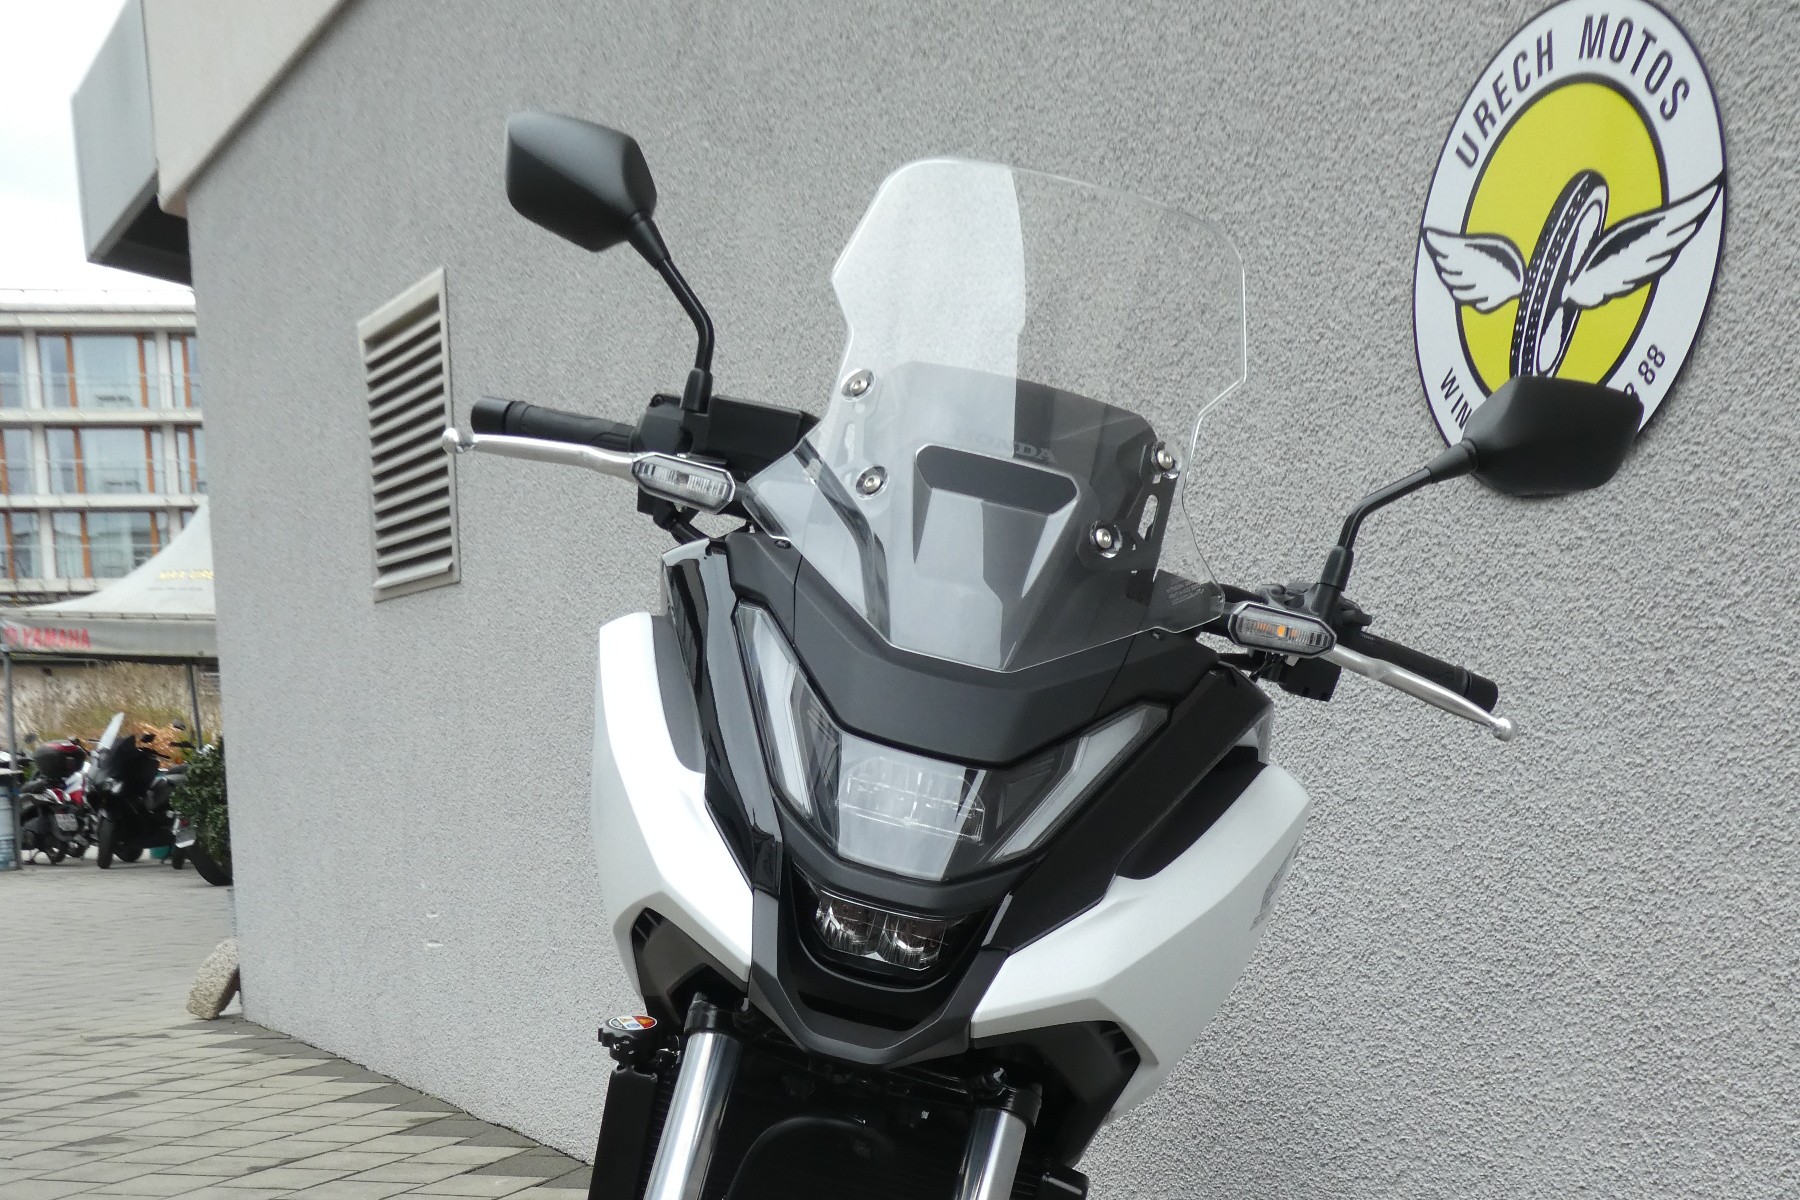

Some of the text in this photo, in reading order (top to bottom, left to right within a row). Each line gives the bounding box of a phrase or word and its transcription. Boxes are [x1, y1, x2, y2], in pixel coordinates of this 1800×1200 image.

[1455, 14, 1691, 170] URECH MOTOS
[22, 626, 92, 649] YAMAHA
